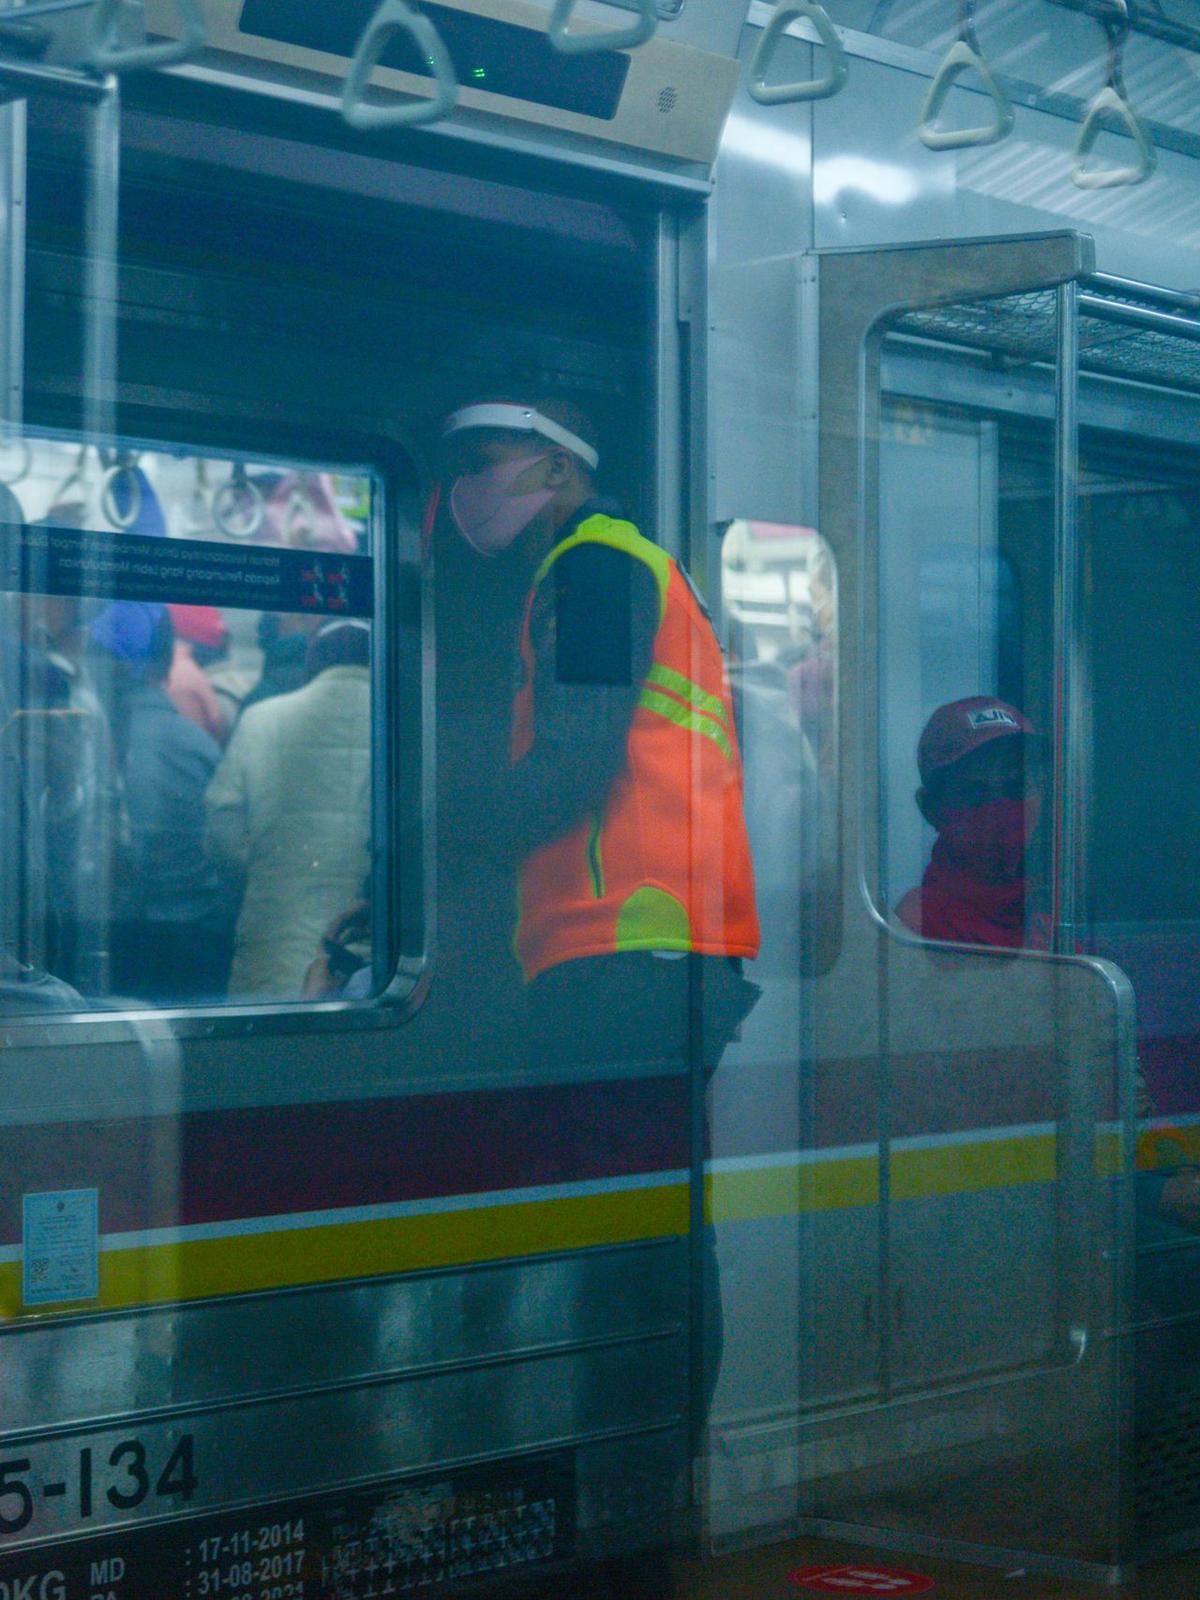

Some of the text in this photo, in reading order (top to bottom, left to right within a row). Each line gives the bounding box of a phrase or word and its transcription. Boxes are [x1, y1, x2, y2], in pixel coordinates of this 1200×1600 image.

[90, 1557, 125, 1586] MD
[198, 1518, 305, 1563] 17-11-2014
[197, 1549, 306, 1595] 31-08-2017
